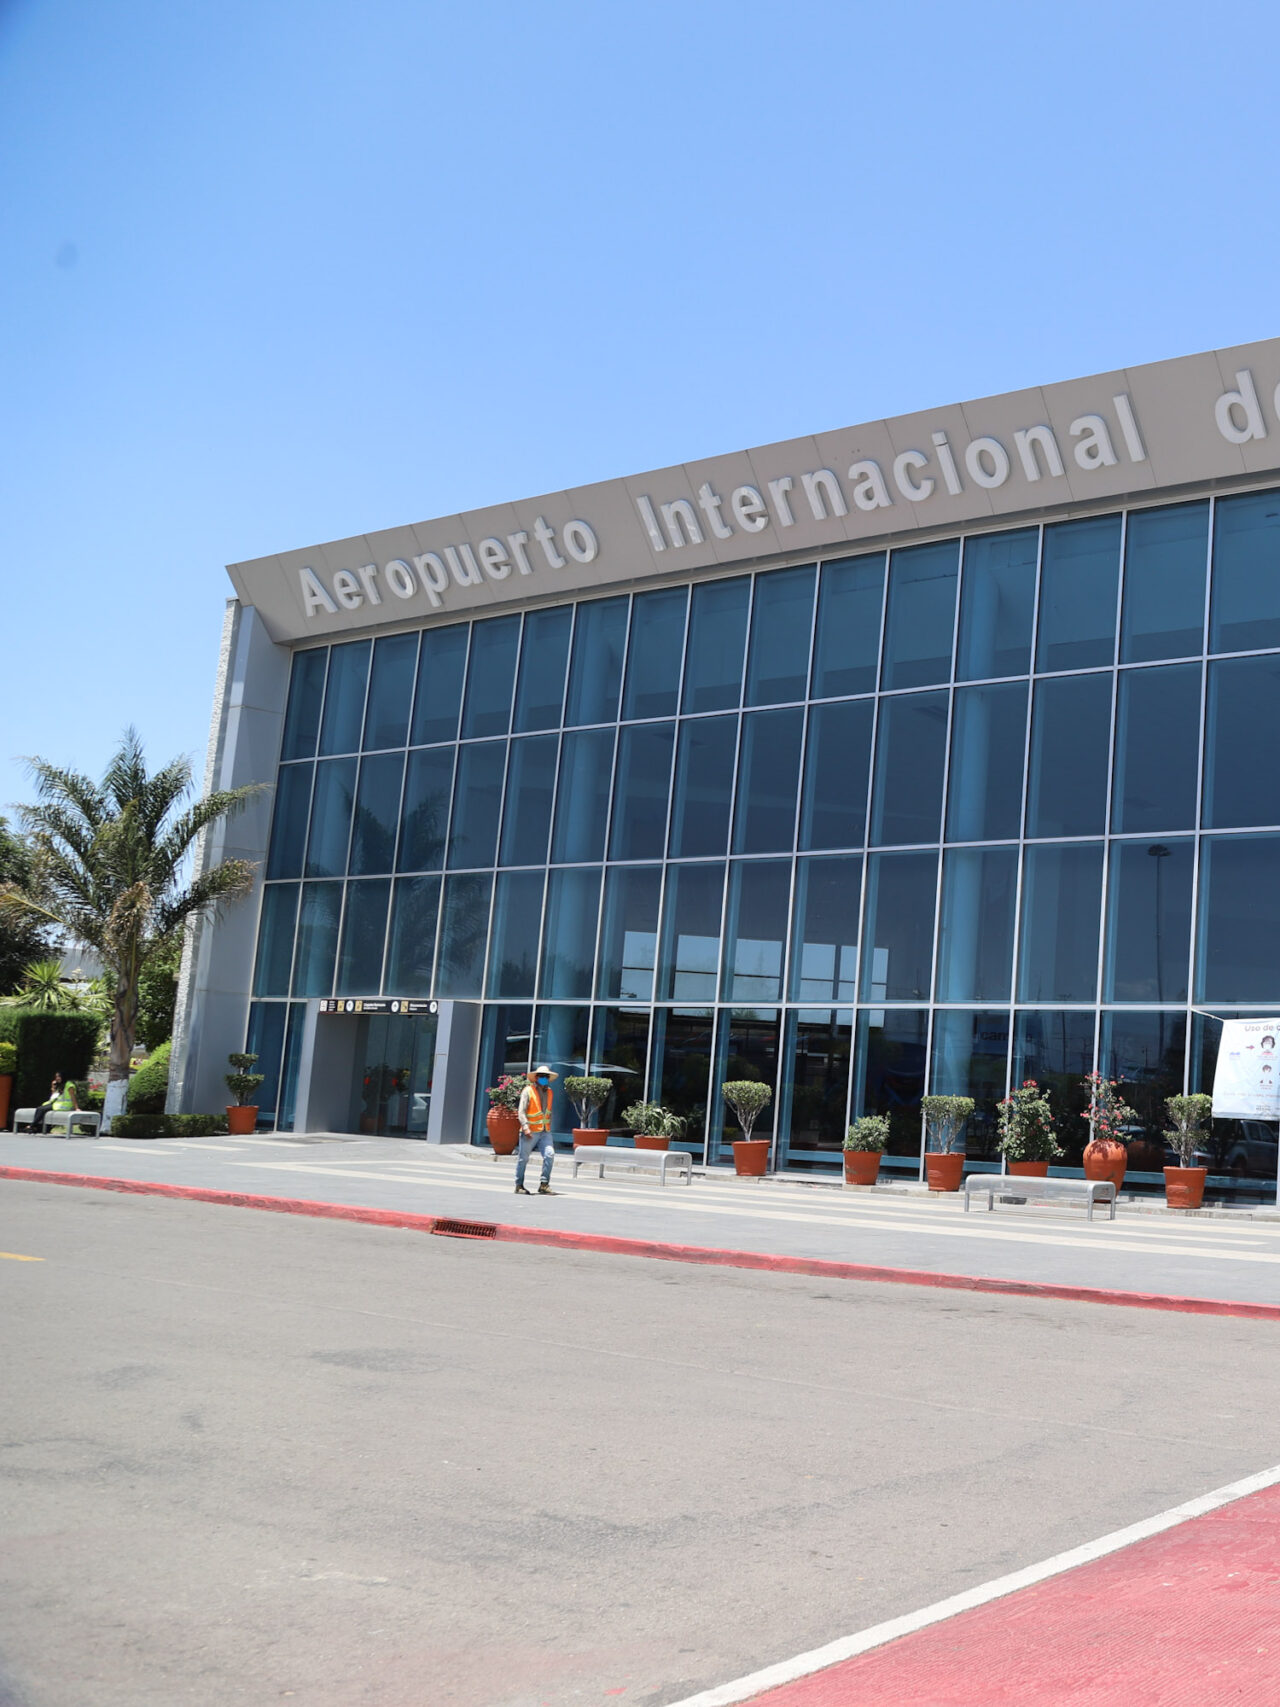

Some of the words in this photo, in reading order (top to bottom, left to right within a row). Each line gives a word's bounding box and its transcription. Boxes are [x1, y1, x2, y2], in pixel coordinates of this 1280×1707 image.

[299, 514, 598, 617] Aeropuerto
[636, 394, 1145, 552] Internacional
[1244, 1024, 1261, 1032] Uso
[1262, 1023, 1274, 1032] de
